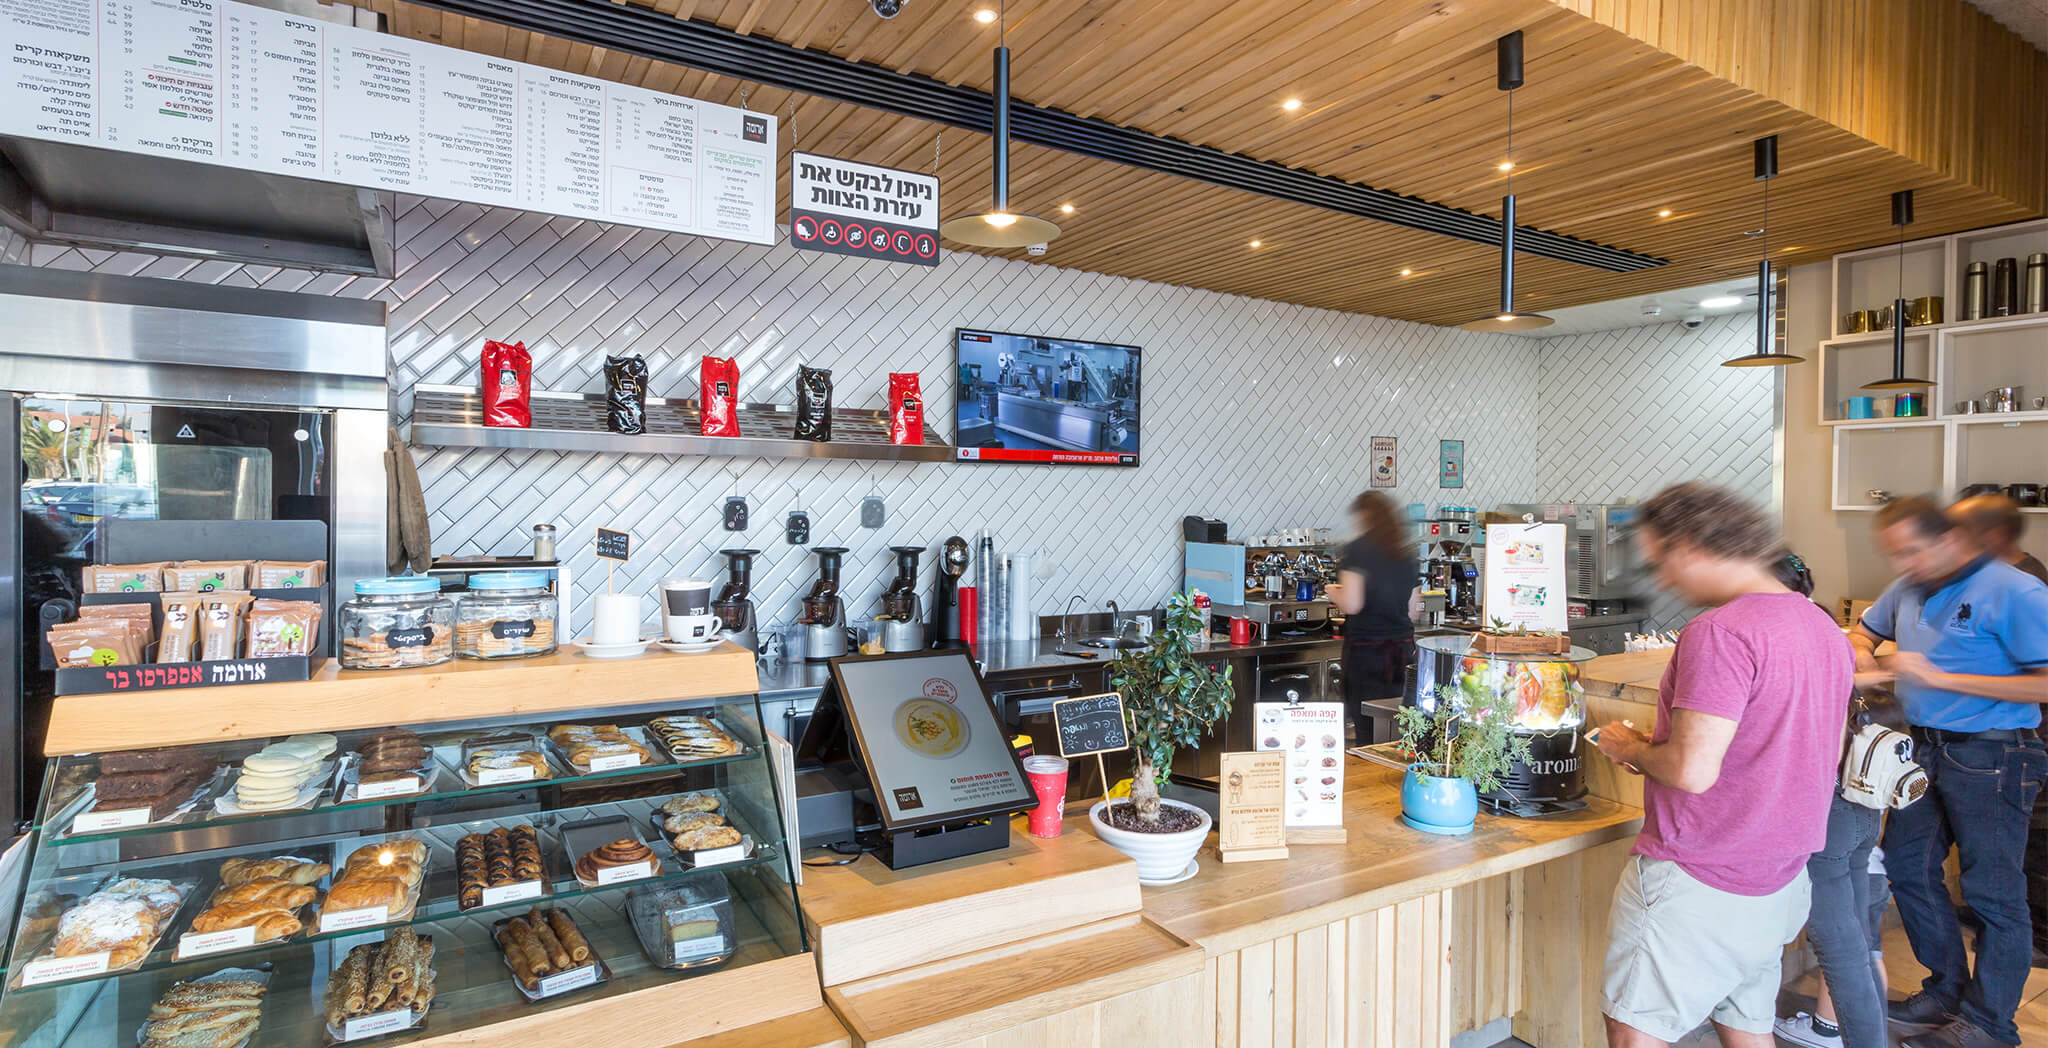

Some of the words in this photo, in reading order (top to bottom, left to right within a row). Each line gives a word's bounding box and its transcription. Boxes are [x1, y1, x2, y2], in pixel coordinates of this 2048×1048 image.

[200, 20, 213, 28] עוף
[285, 20, 316, 32] כריכים
[189, 26, 213, 36] ארומה
[196, 35, 213, 44] טונה
[293, 39, 317, 48] חביתה
[15, 43, 43, 56] קרים
[192, 43, 213, 52] חלומי
[44, 49, 91, 63] משקאות
[184, 49, 213, 59] ירושלמי
[300, 49, 316, 57] טונה
[13, 56, 43, 67] וכורכום
[45, 61, 62, 70] דבש
[487, 62, 513, 73] מאפים
[59, 78, 91, 89] לימונדה
[142, 80, 159, 89] אפוי
[292, 75, 316, 85] אבוקדו
[549, 75, 570, 86] חמים
[160, 84, 184, 94] וסלמון
[297, 85, 316, 94] חלומי
[570, 79, 601, 92] משקאות
[75, 90, 91, 99] מים
[288, 93, 316, 104] רוסטביף
[50, 96, 67, 107] קלה
[68, 99, 91, 109] שתיה
[187, 96, 213, 106] ישראלי
[653, 96, 669, 106] בוקר
[41, 105, 74, 116] בטעמים
[192, 105, 213, 115] פסטה
[297, 103, 316, 113] סלמון
[669, 101, 694, 112] ארוחות
[75, 110, 91, 119] מים
[188, 112, 213, 123] קינואה
[59, 117, 71, 126] תה
[73, 119, 91, 128] אייס
[36, 123, 57, 133] דיאט
[59, 126, 71, 135] תה
[73, 128, 91, 137] אייס
[370, 131, 392, 142] גלוטן
[393, 135, 410, 144] ללא
[137, 138, 164, 149] וחמאה
[164, 142, 182, 152] לחם
[181, 136, 213, 148] מרקים
[281, 157, 301, 167] ביצים
[302, 159, 316, 168] סלט
[799, 162, 832, 184] את
[639, 174, 665, 184] טוסטים
[836, 169, 894, 194] לבקש
[897, 180, 933, 201] ניתן
[810, 186, 870, 212] הצוות
[872, 196, 923, 221] עזרת
[135, 665, 204, 688] אספרסו
[211, 662, 267, 683] ארומה
[105, 669, 131, 689] בר
[1290, 710, 1317, 718] ומאפה
[1319, 710, 1337, 720] קפה
